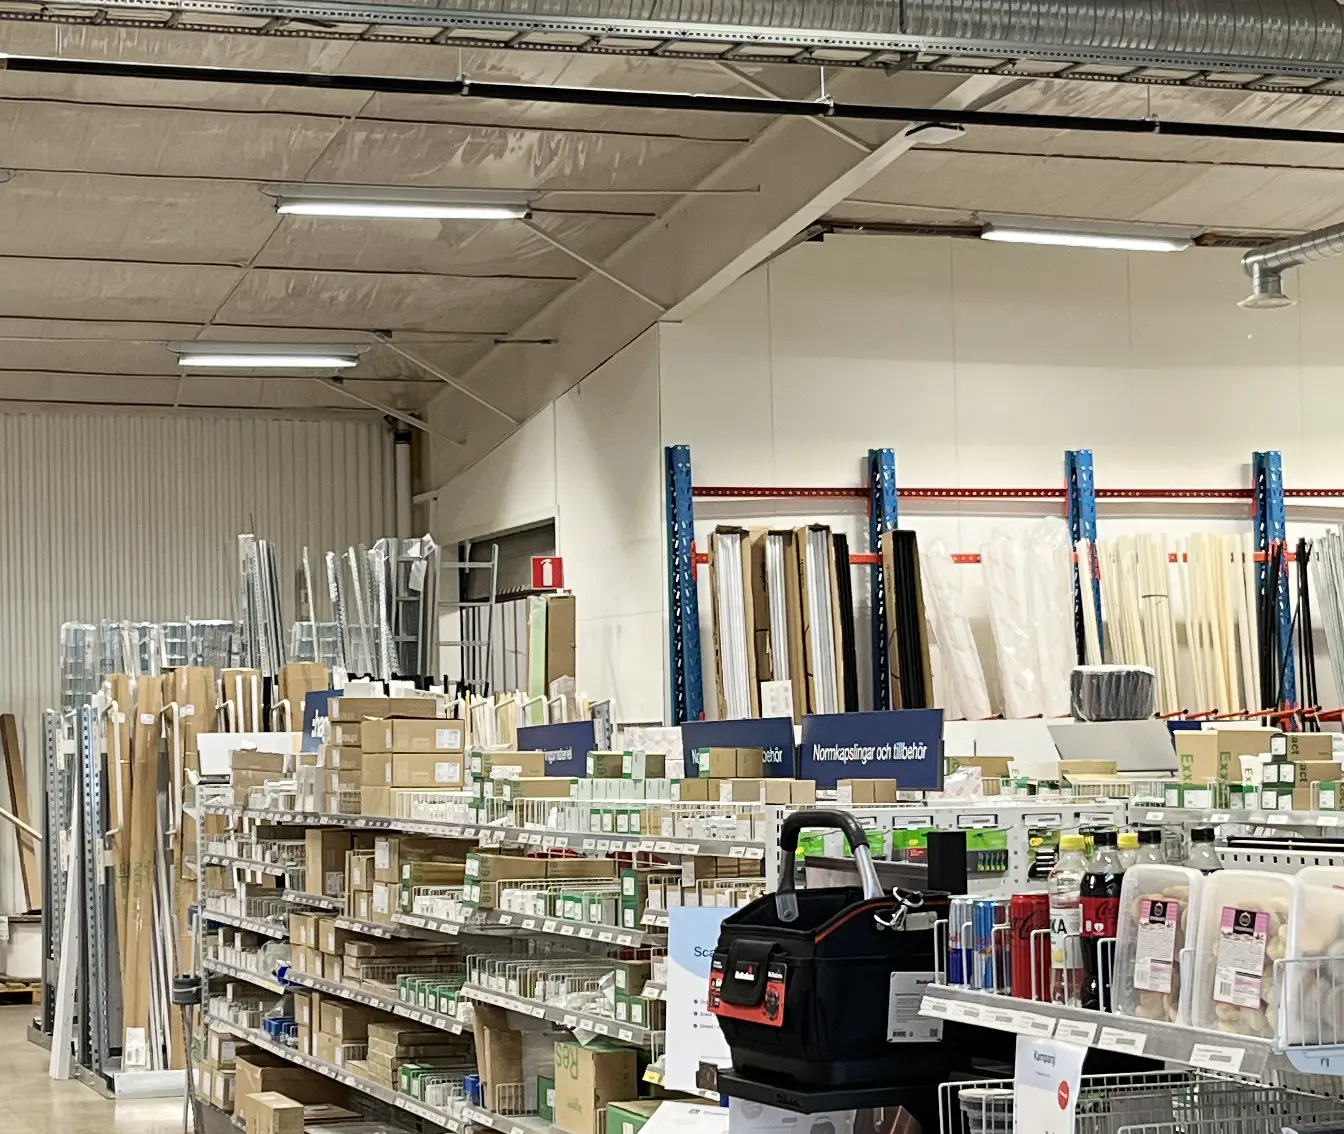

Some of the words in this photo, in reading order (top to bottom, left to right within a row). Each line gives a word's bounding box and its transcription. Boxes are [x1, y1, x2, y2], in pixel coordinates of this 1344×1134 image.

[812, 743, 875, 762] Normkapslingar
[877, 745, 891, 760] och
[893, 742, 928, 760] tillbehör
